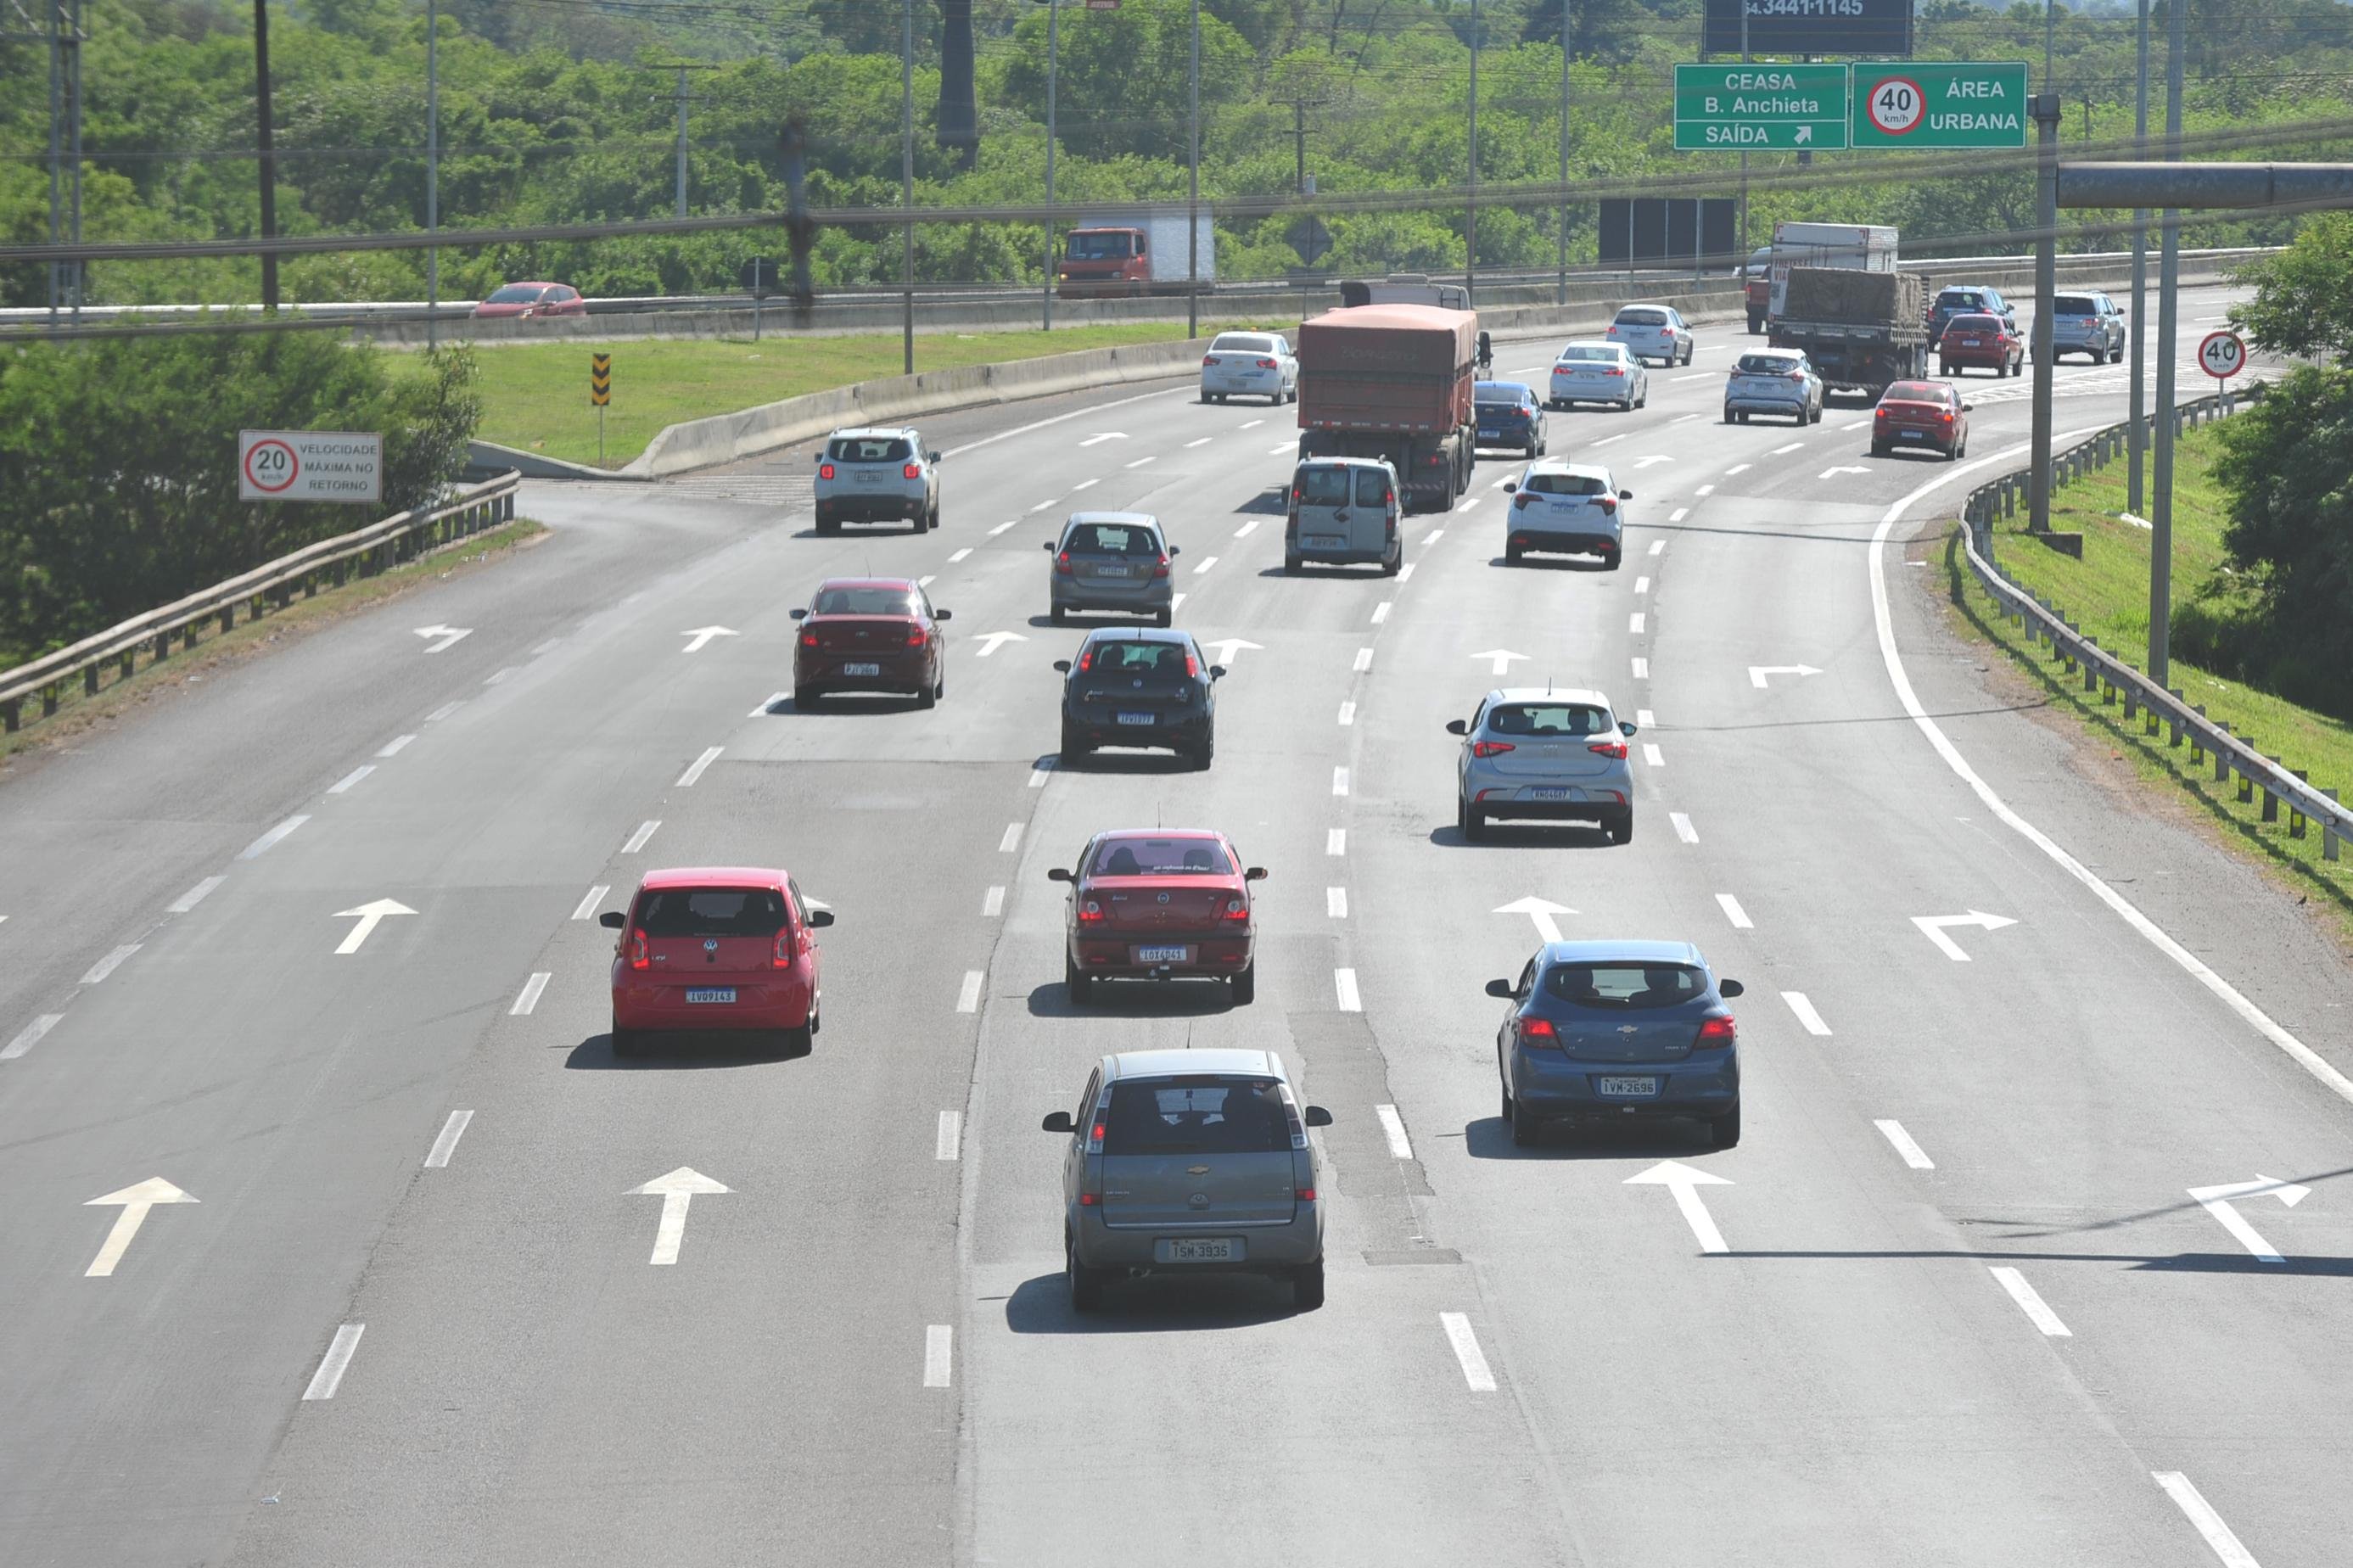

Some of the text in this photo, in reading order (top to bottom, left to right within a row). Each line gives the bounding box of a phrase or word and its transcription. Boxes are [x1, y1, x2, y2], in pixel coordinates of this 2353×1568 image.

[1725, 74, 1796, 90] CEASA
[1947, 77, 2004, 98] ÁREA
[1705, 97, 1818, 113] B. Anchieta
[1880, 88, 1912, 111] 40
[1884, 114, 1909, 123] km/h
[1930, 114, 2019, 130] URBANA
[1706, 123, 1768, 143] SAÍDA
[2206, 341, 2236, 361] 40
[300, 444, 378, 456] VELOCIDADE
[257, 450, 286, 471] 20
[305, 460, 373, 473] MÁXIMA NO
[309, 480, 368, 491] RETORNO
[1604, 1083, 1654, 1094] IVM-2696
[1174, 1246, 1228, 1257] ISM-3935
